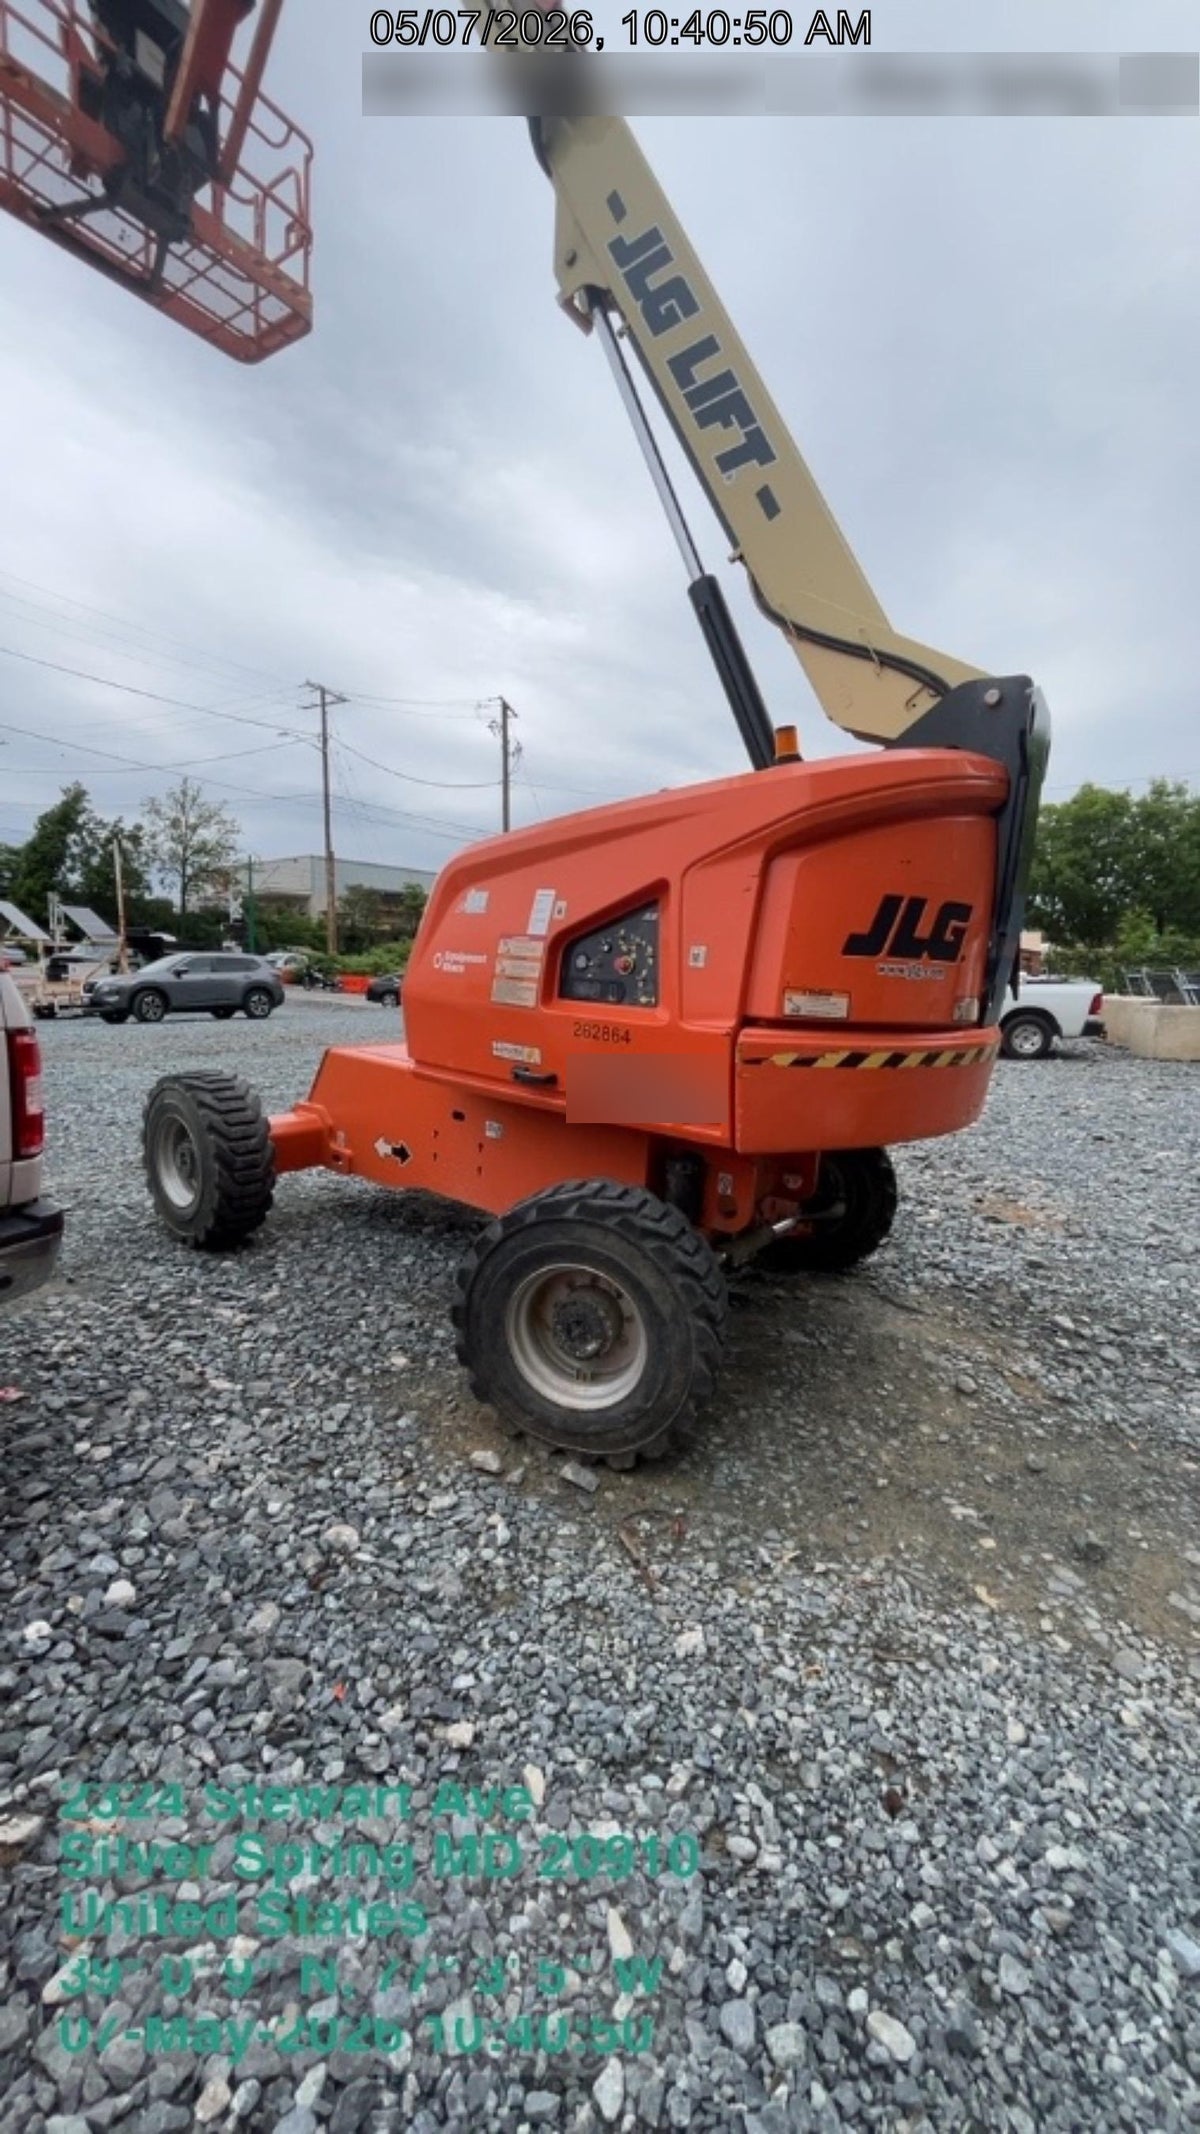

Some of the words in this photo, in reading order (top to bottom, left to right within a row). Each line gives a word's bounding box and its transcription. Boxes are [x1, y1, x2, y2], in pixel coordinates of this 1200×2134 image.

[606, 225, 702, 338] JLG
[665, 333, 778, 476] LIFT
[841, 893, 974, 963] JLG
[573, 1021, 632, 1044] 262864
